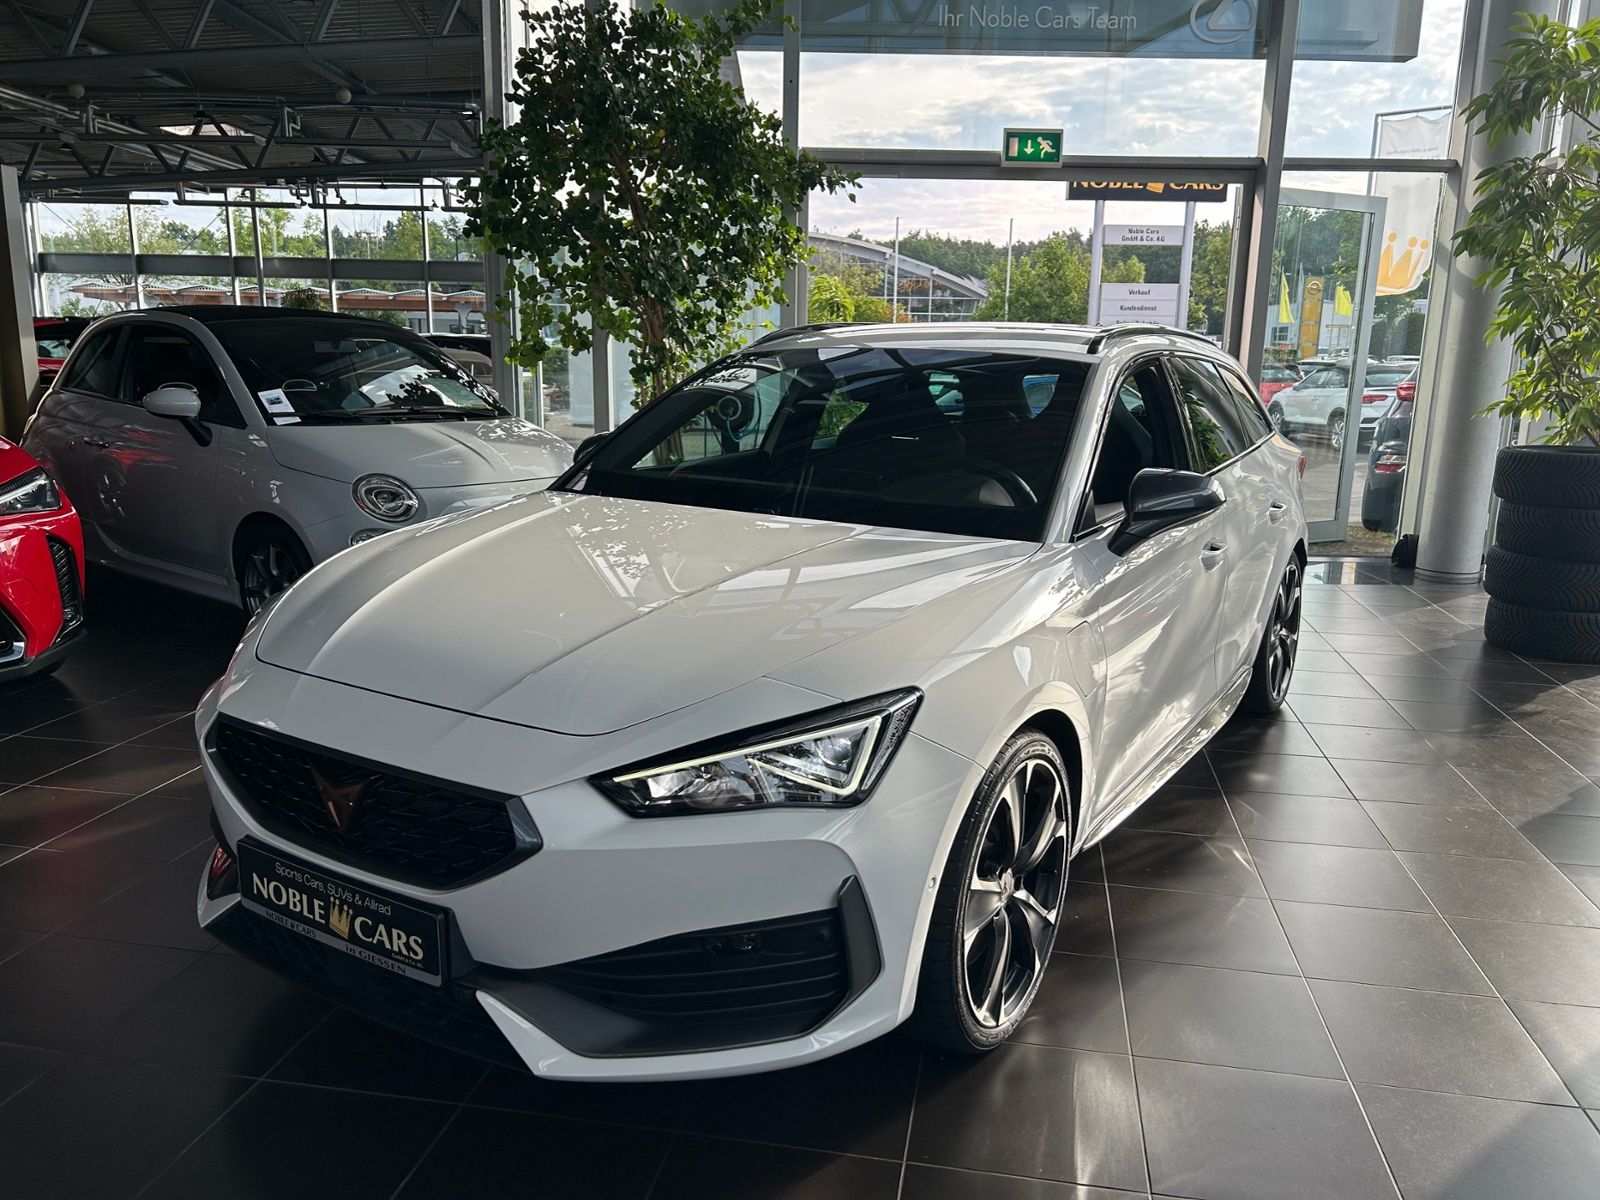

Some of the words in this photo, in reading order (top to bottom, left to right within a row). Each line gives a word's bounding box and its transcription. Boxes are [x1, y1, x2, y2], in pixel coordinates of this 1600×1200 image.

[938, 4, 964, 28] Ihr
[969, 5, 1029, 29] Noble
[1035, 6, 1082, 29] Cars
[1088, 7, 1137, 30] Team
[275, 861, 303, 883] Sports
[303, 873, 327, 894] Cars,
[327, 883, 353, 902] SUVs
[354, 893, 363, 906] &
[364, 896, 391, 916] Allrad
[252, 872, 326, 925] NOBLE
[354, 916, 424, 961] CARS
[296, 923, 317, 938] CARS
[345, 944, 356, 954] in
[358, 948, 407, 974] GIESSEN
